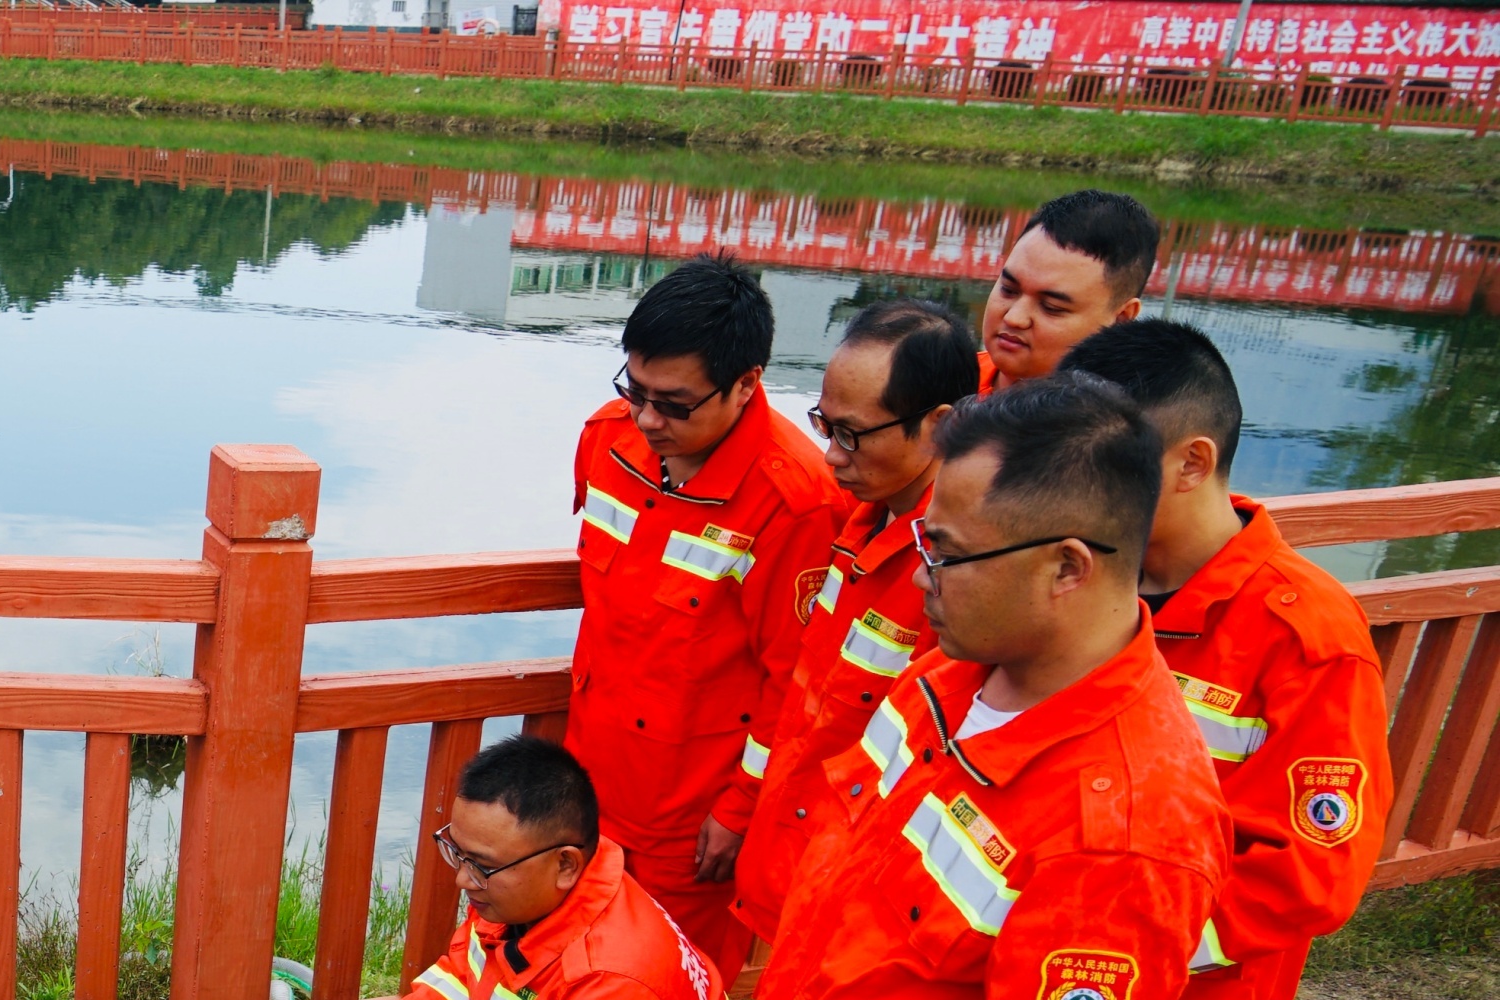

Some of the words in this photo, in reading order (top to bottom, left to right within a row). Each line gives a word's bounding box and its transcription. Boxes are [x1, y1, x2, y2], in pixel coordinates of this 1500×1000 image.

[1299, 764, 1356, 775] 中华人民共和国
[1304, 775, 1350, 787] 森林消防
[1052, 957, 1130, 974] 中华人民共和国
[1060, 968, 1117, 985] 森林消防
